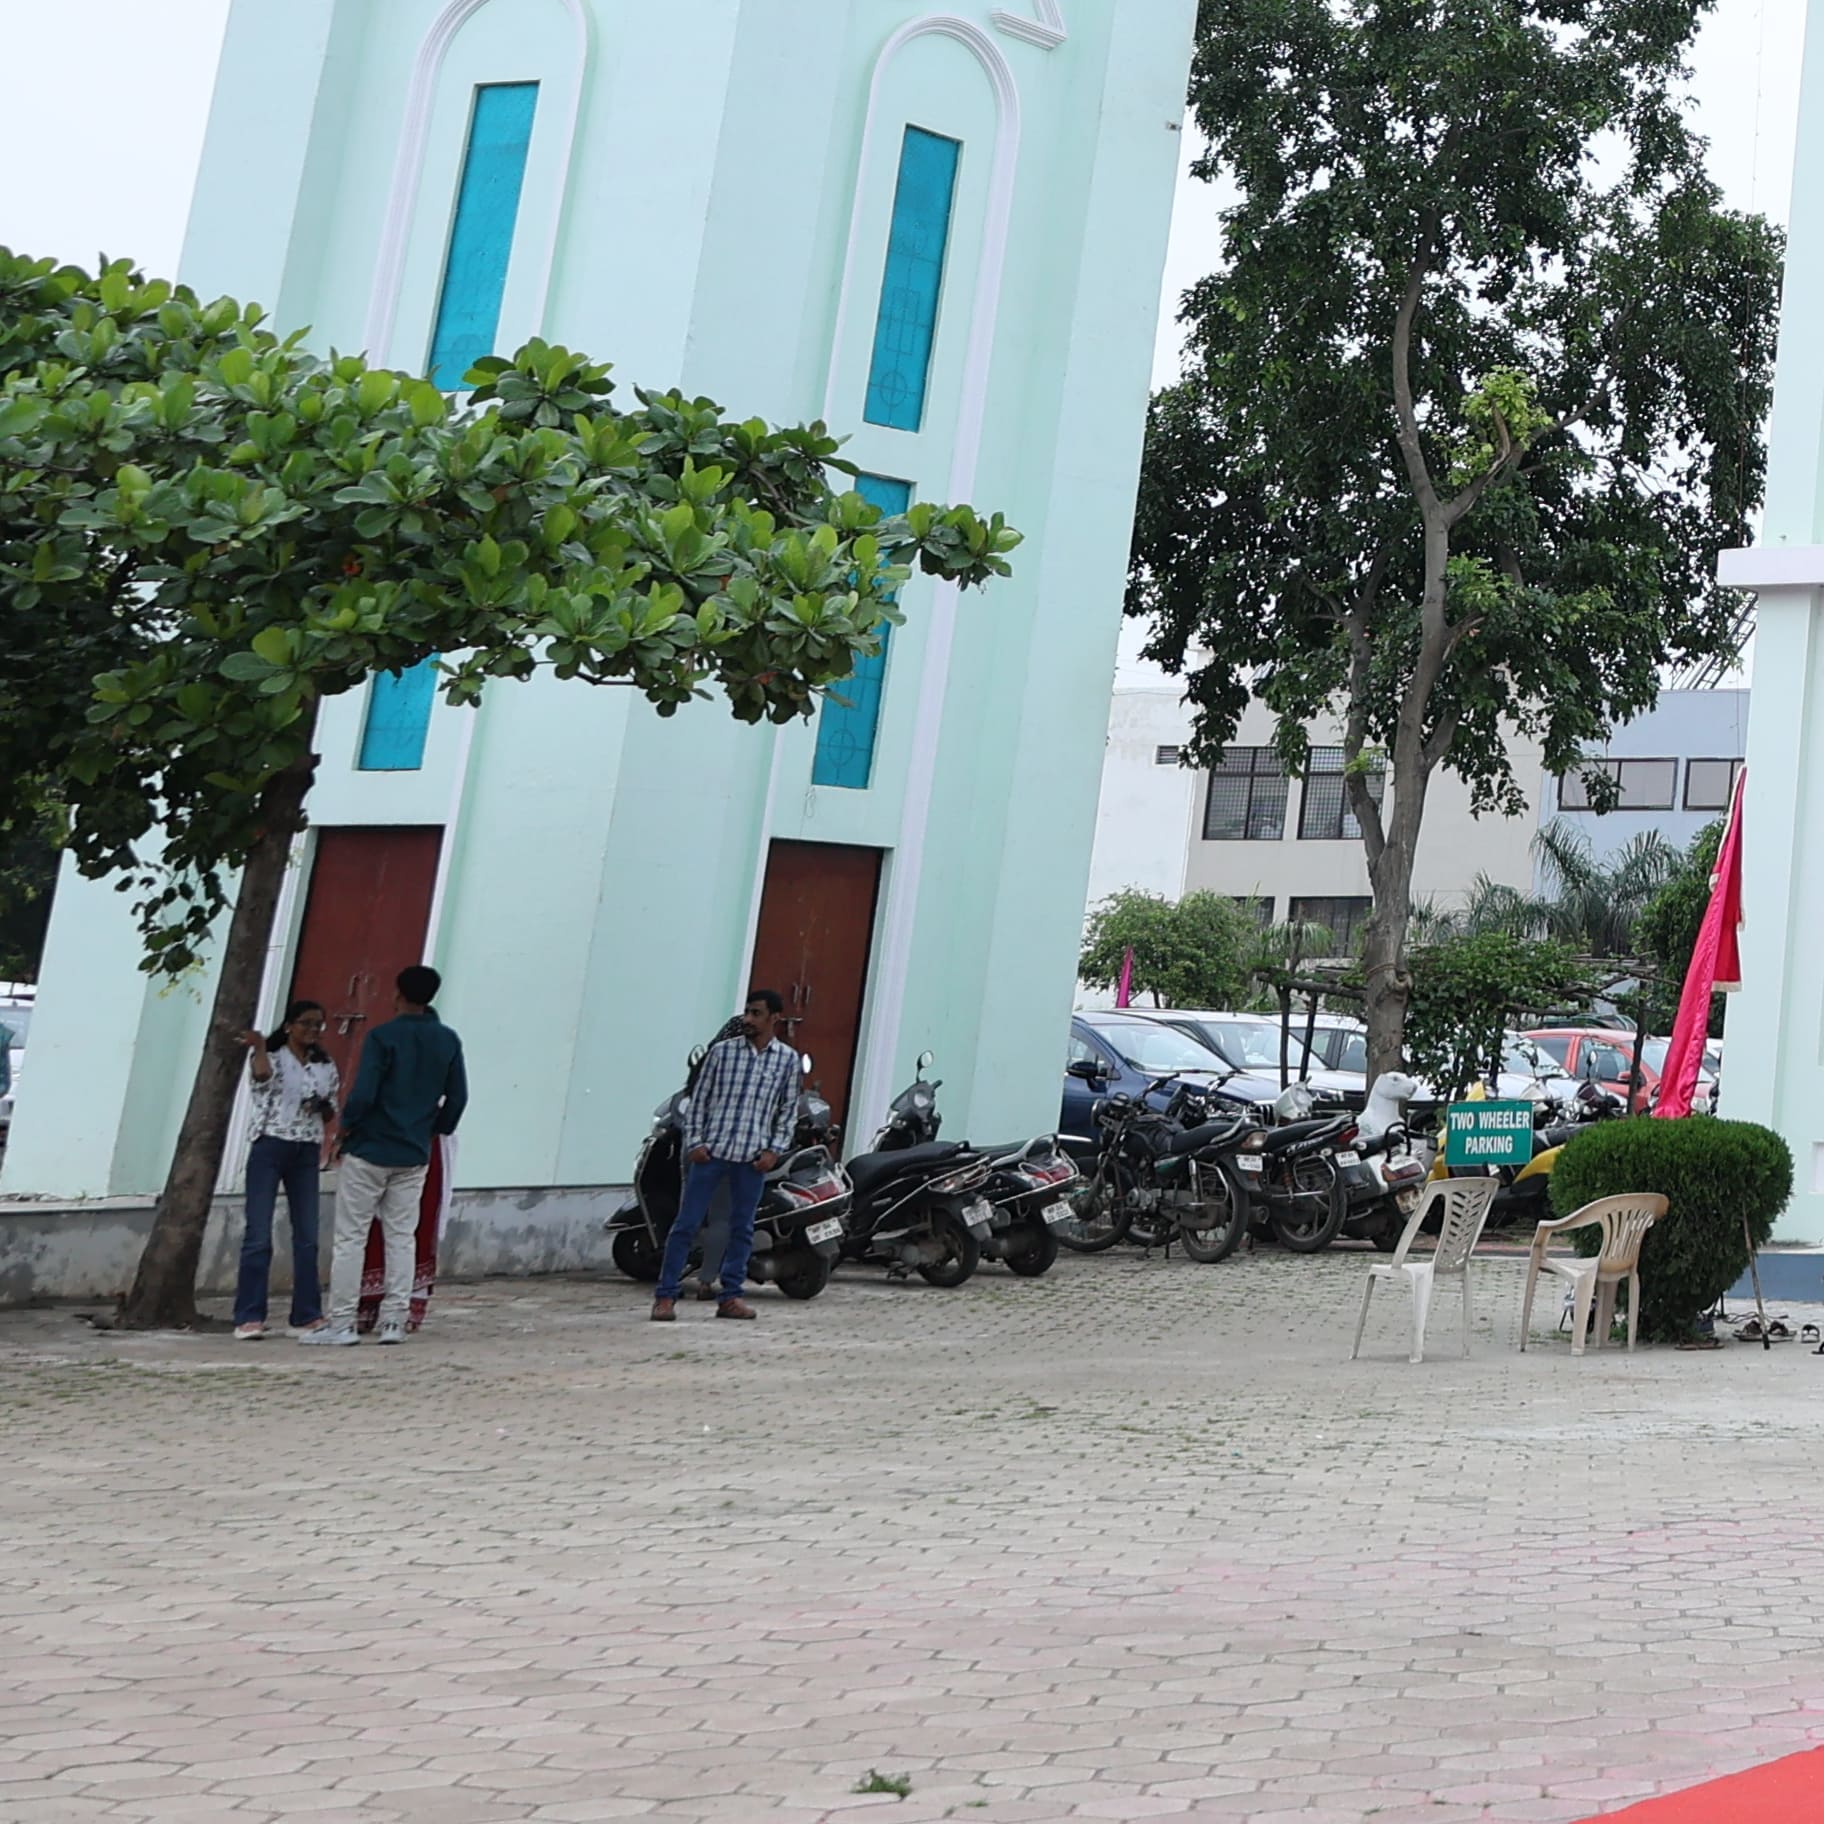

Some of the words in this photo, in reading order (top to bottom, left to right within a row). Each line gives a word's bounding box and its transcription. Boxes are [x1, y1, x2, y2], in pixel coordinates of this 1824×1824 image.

[1450, 1112, 1474, 1130] TWO
[1479, 1111, 1530, 1129] WHEELER
[1465, 1136, 1513, 1155] PARKING
